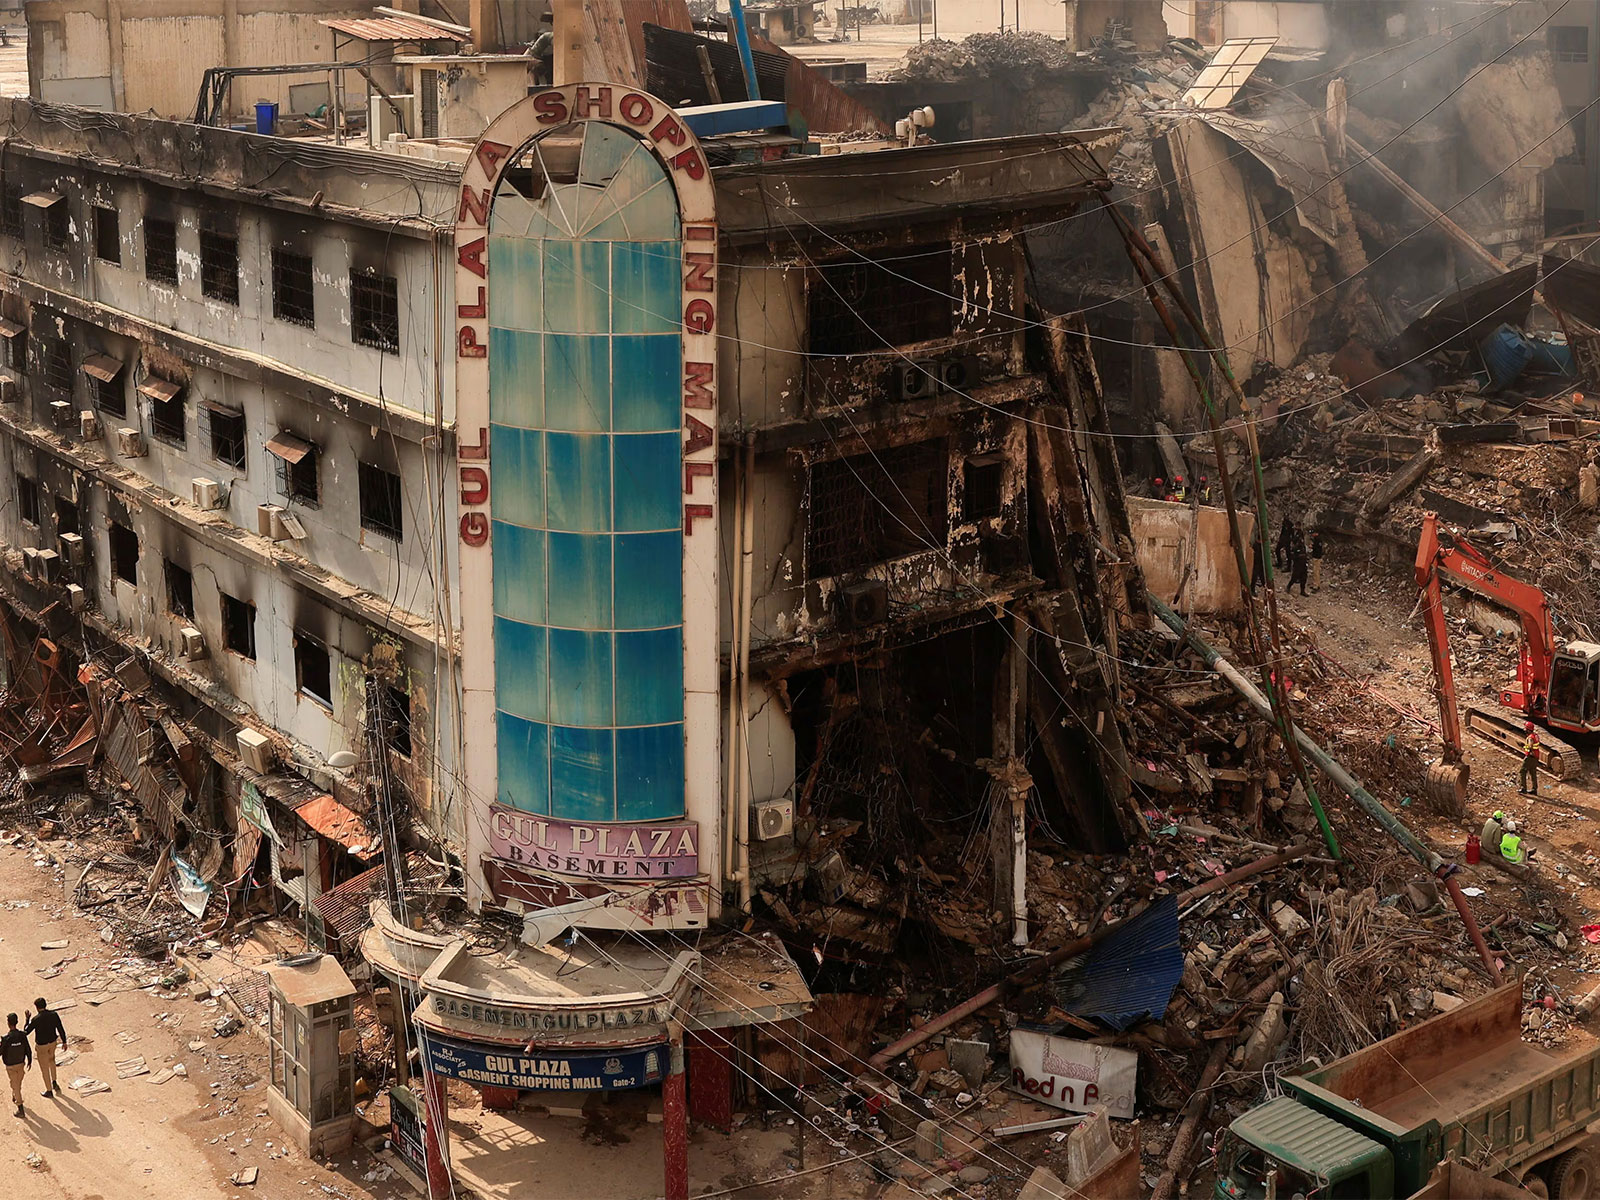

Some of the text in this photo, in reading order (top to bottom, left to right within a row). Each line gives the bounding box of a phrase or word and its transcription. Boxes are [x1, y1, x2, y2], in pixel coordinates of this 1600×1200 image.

[458, 139, 512, 358] PLAZA
[684, 361, 714, 536] MALL
[459, 427, 489, 547] GUL
[491, 812, 698, 858] GUL PLAZA
[509, 845, 675, 876] BASEMENT
[485, 1055, 572, 1077] GUL PLAZA
[511, 1075, 571, 1090] SHOPPING
[572, 1077, 603, 1090] MALL
[612, 1077, 636, 1088] Gate-2
[1012, 1066, 1055, 1098] Red
[1061, 1086, 1074, 1103] n
